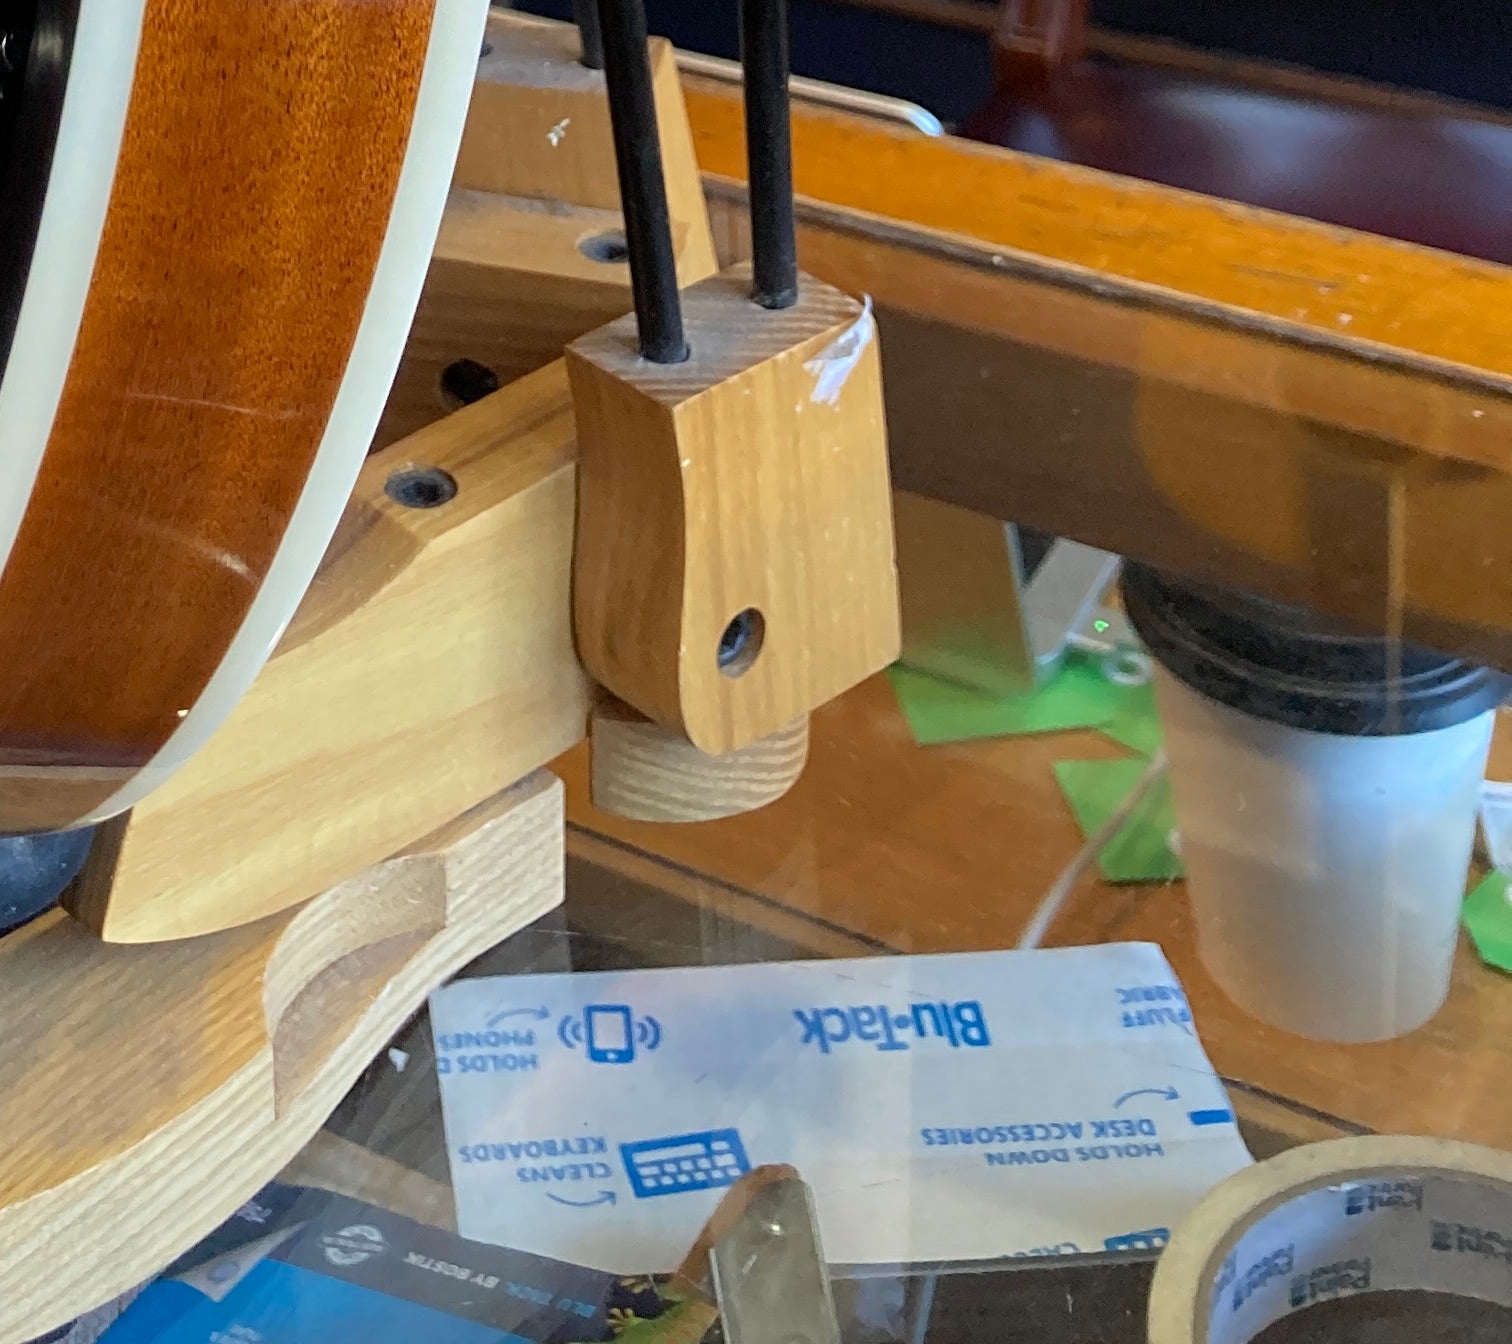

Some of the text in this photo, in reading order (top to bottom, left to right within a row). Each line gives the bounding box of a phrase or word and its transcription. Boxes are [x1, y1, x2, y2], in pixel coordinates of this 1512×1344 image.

[457, 1054, 538, 1073] HOLDS
[921, 1118, 1157, 1146] DESK ACCESSORIES
[458, 1135, 608, 1163] KEYBOARDS
[985, 1143, 1165, 1167] HOLDS DOWN
[516, 1163, 613, 1183] CLEANS
